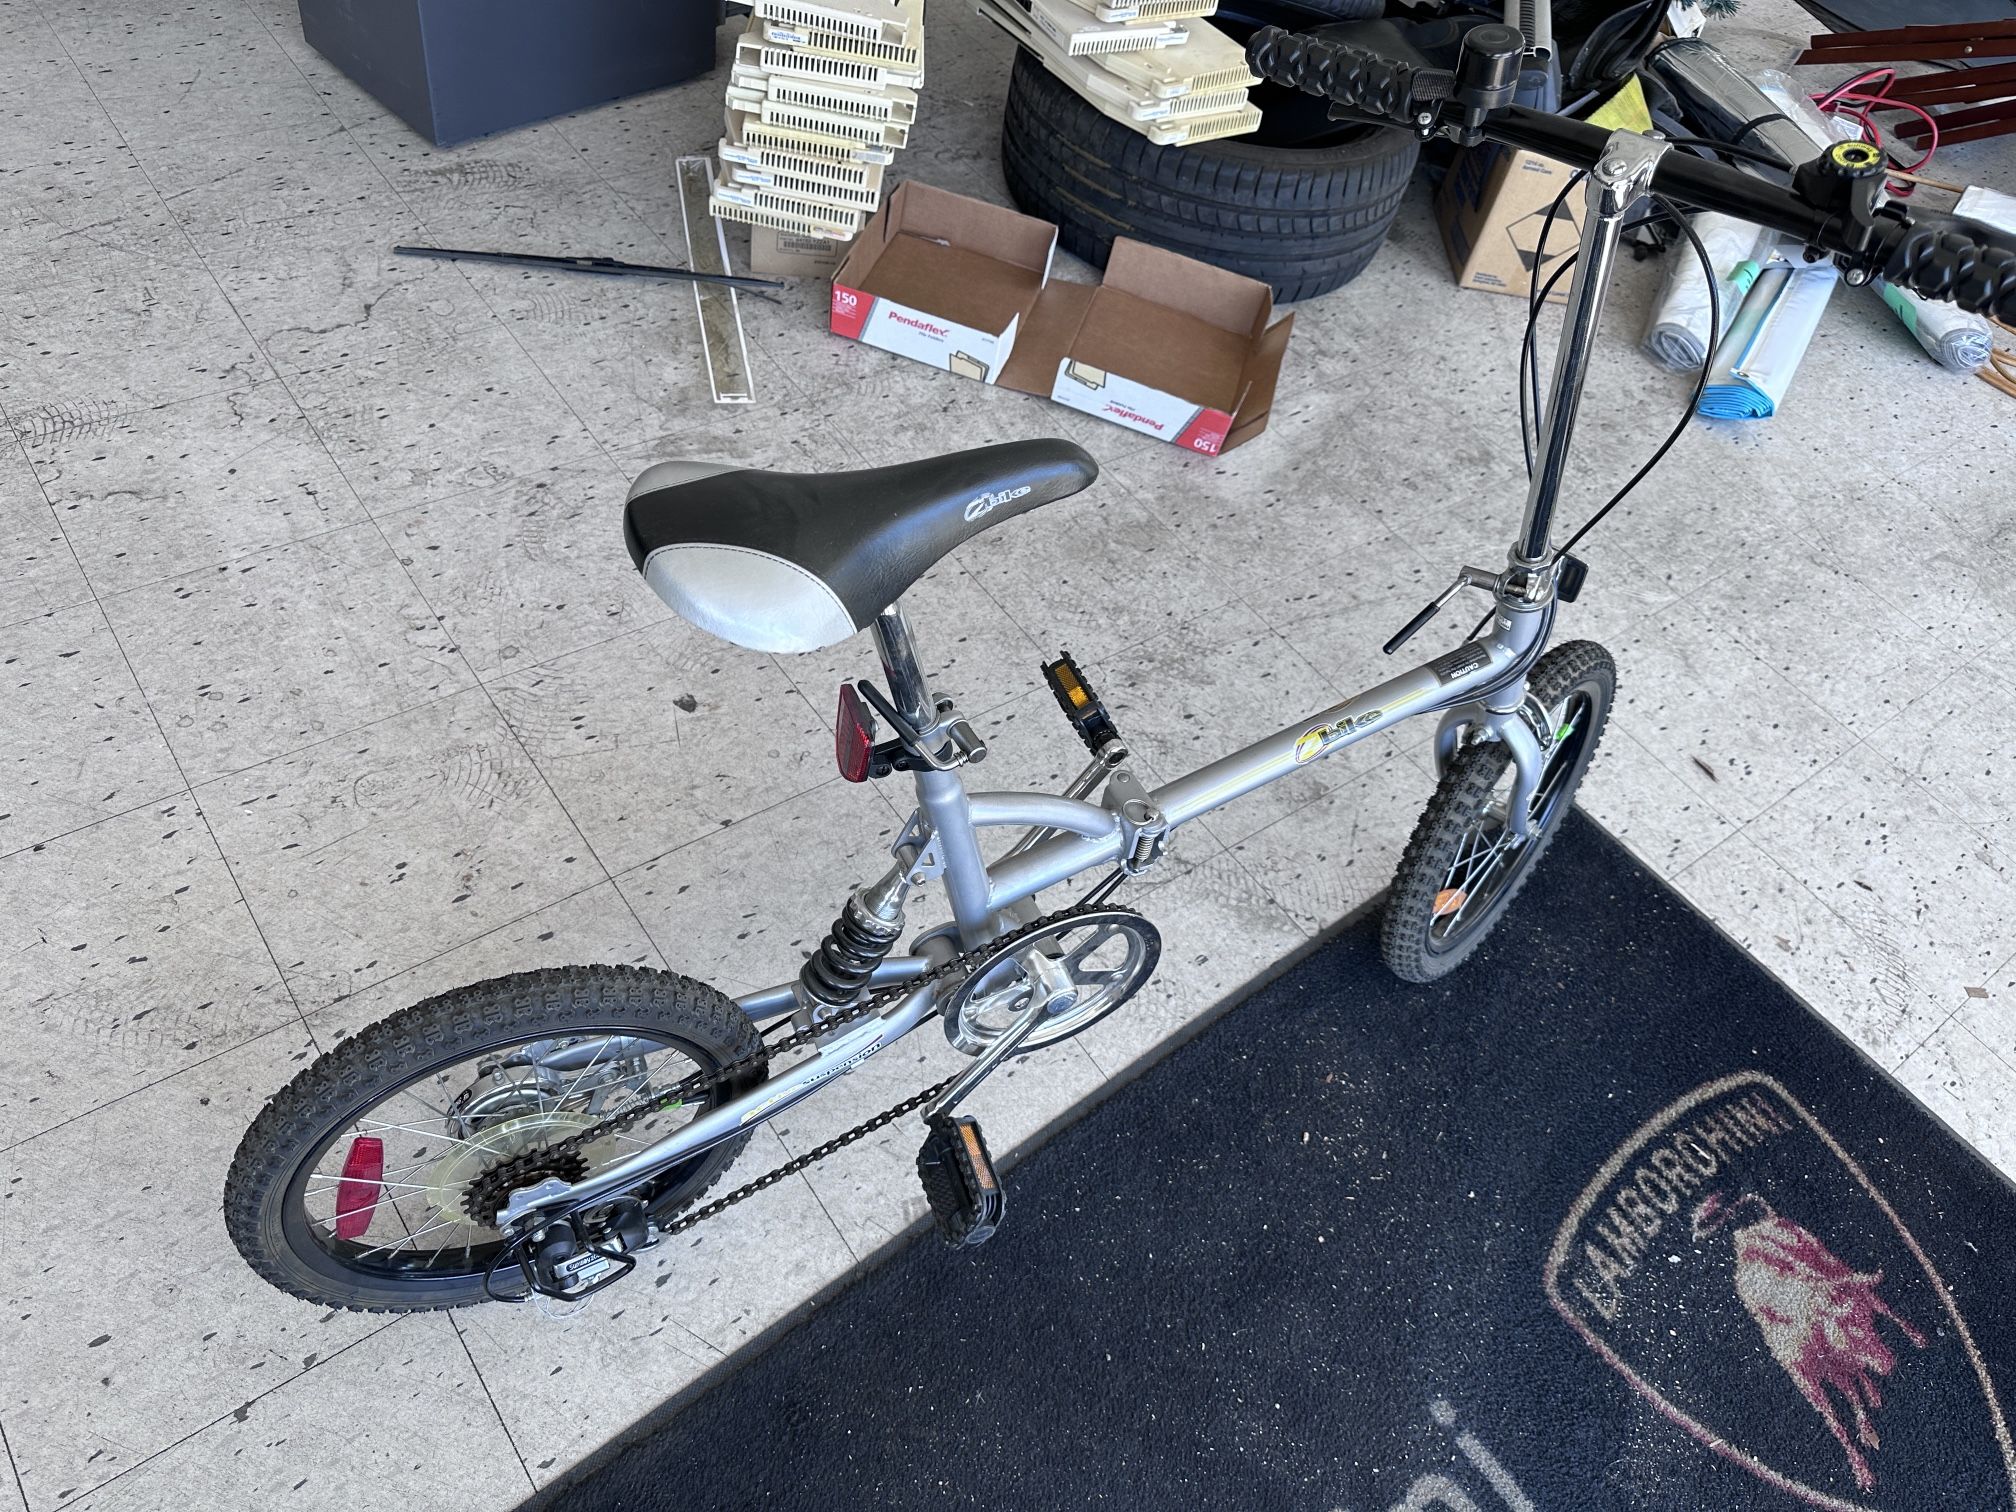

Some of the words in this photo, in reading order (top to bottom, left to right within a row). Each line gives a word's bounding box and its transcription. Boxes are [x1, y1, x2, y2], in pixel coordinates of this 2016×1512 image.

[834, 290, 858, 306] 150
[888, 311, 950, 337] Pendaflex
[1102, 404, 1165, 431] Pendaflex
[1193, 438, 1217, 453] 150
[1451, 662, 1479, 679] CAUTION
[802, 1043, 881, 1086] suspension
